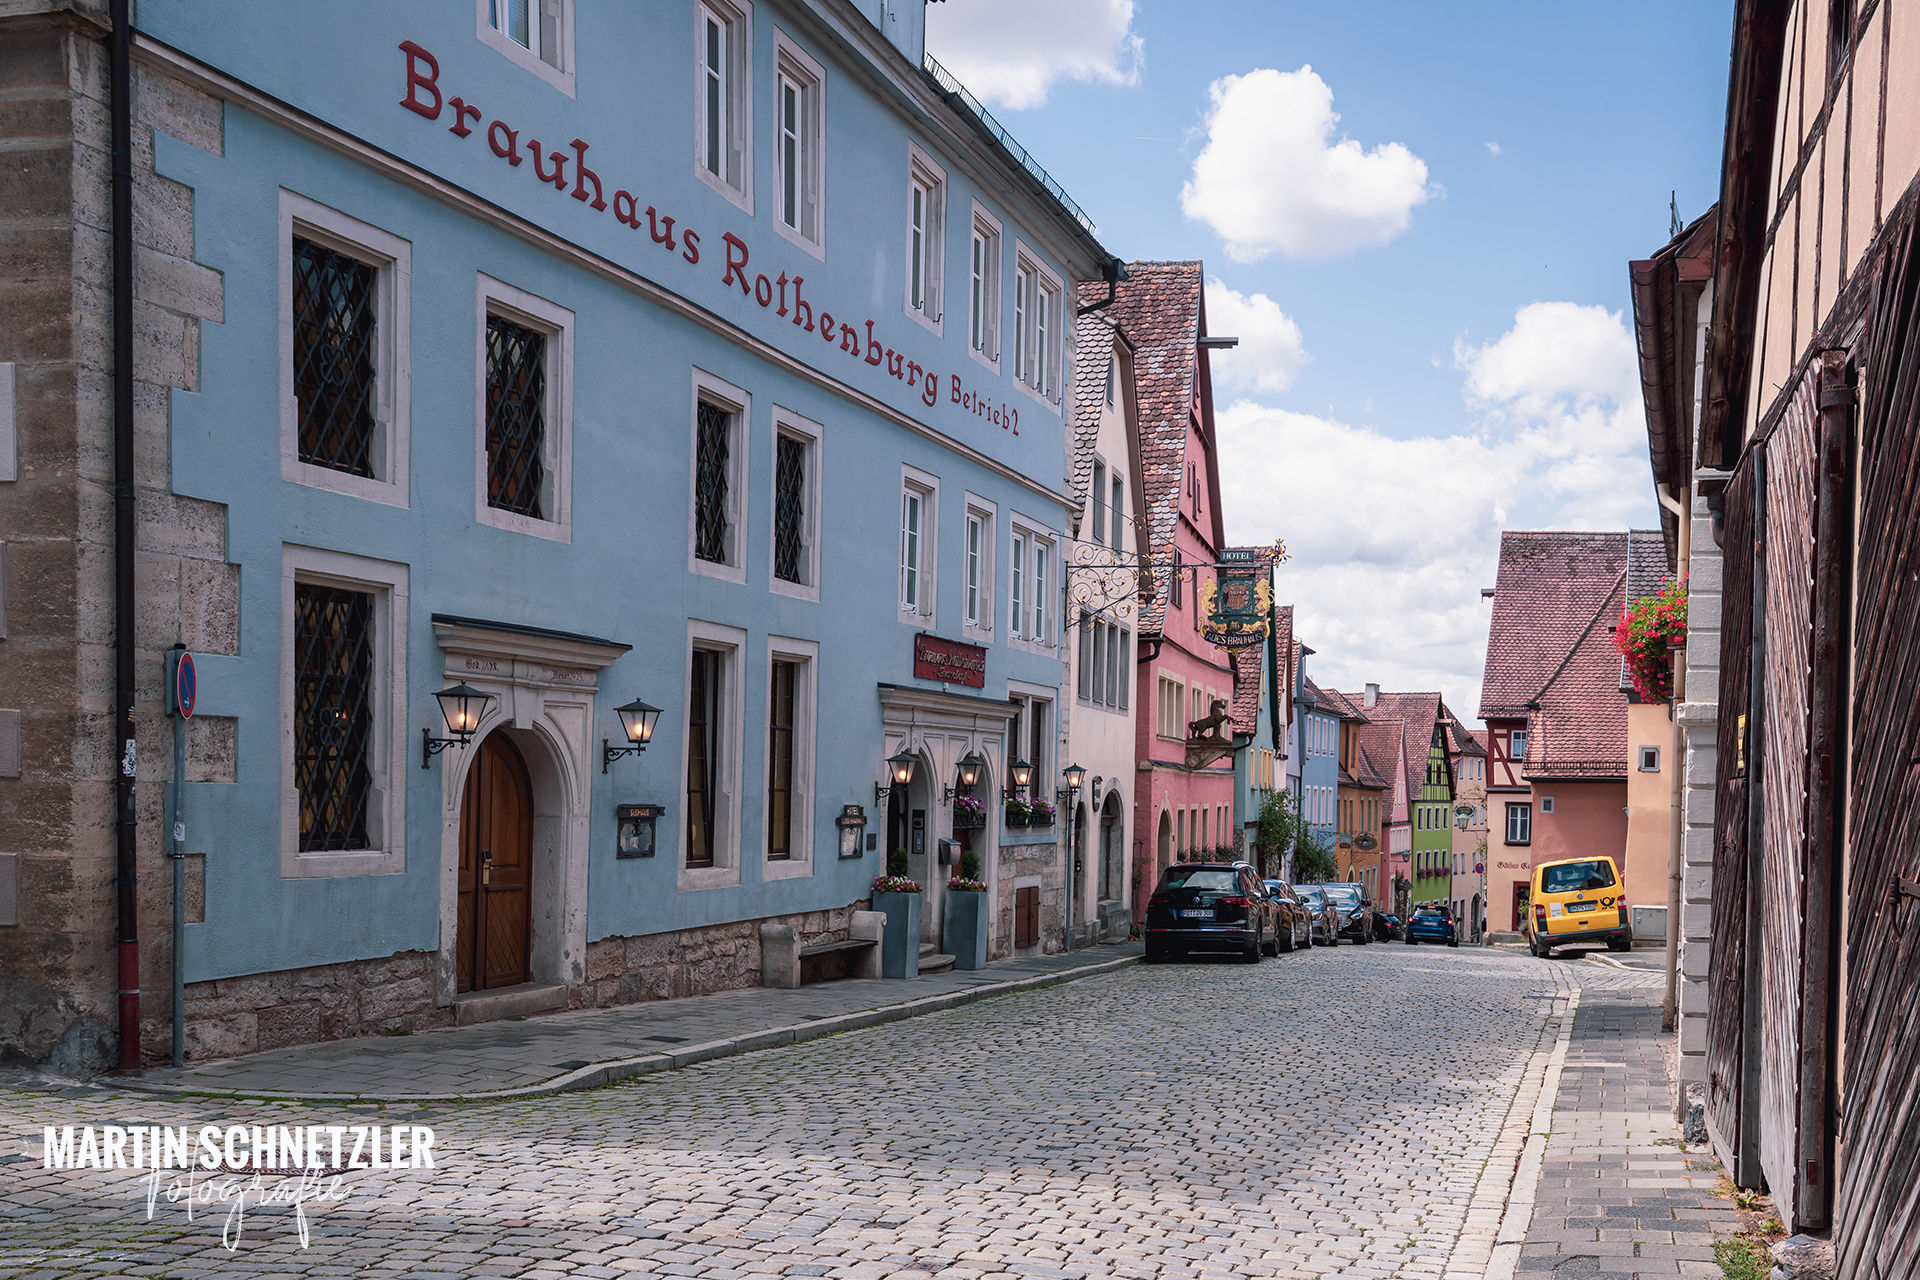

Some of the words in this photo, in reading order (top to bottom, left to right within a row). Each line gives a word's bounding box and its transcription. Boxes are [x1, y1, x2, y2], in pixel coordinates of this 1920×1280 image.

[398, 39, 701, 265] Brauhaus
[721, 231, 939, 407] Rothenburg
[1222, 552, 1252, 560] HOTEL
[1206, 632, 1227, 643] ALTES
